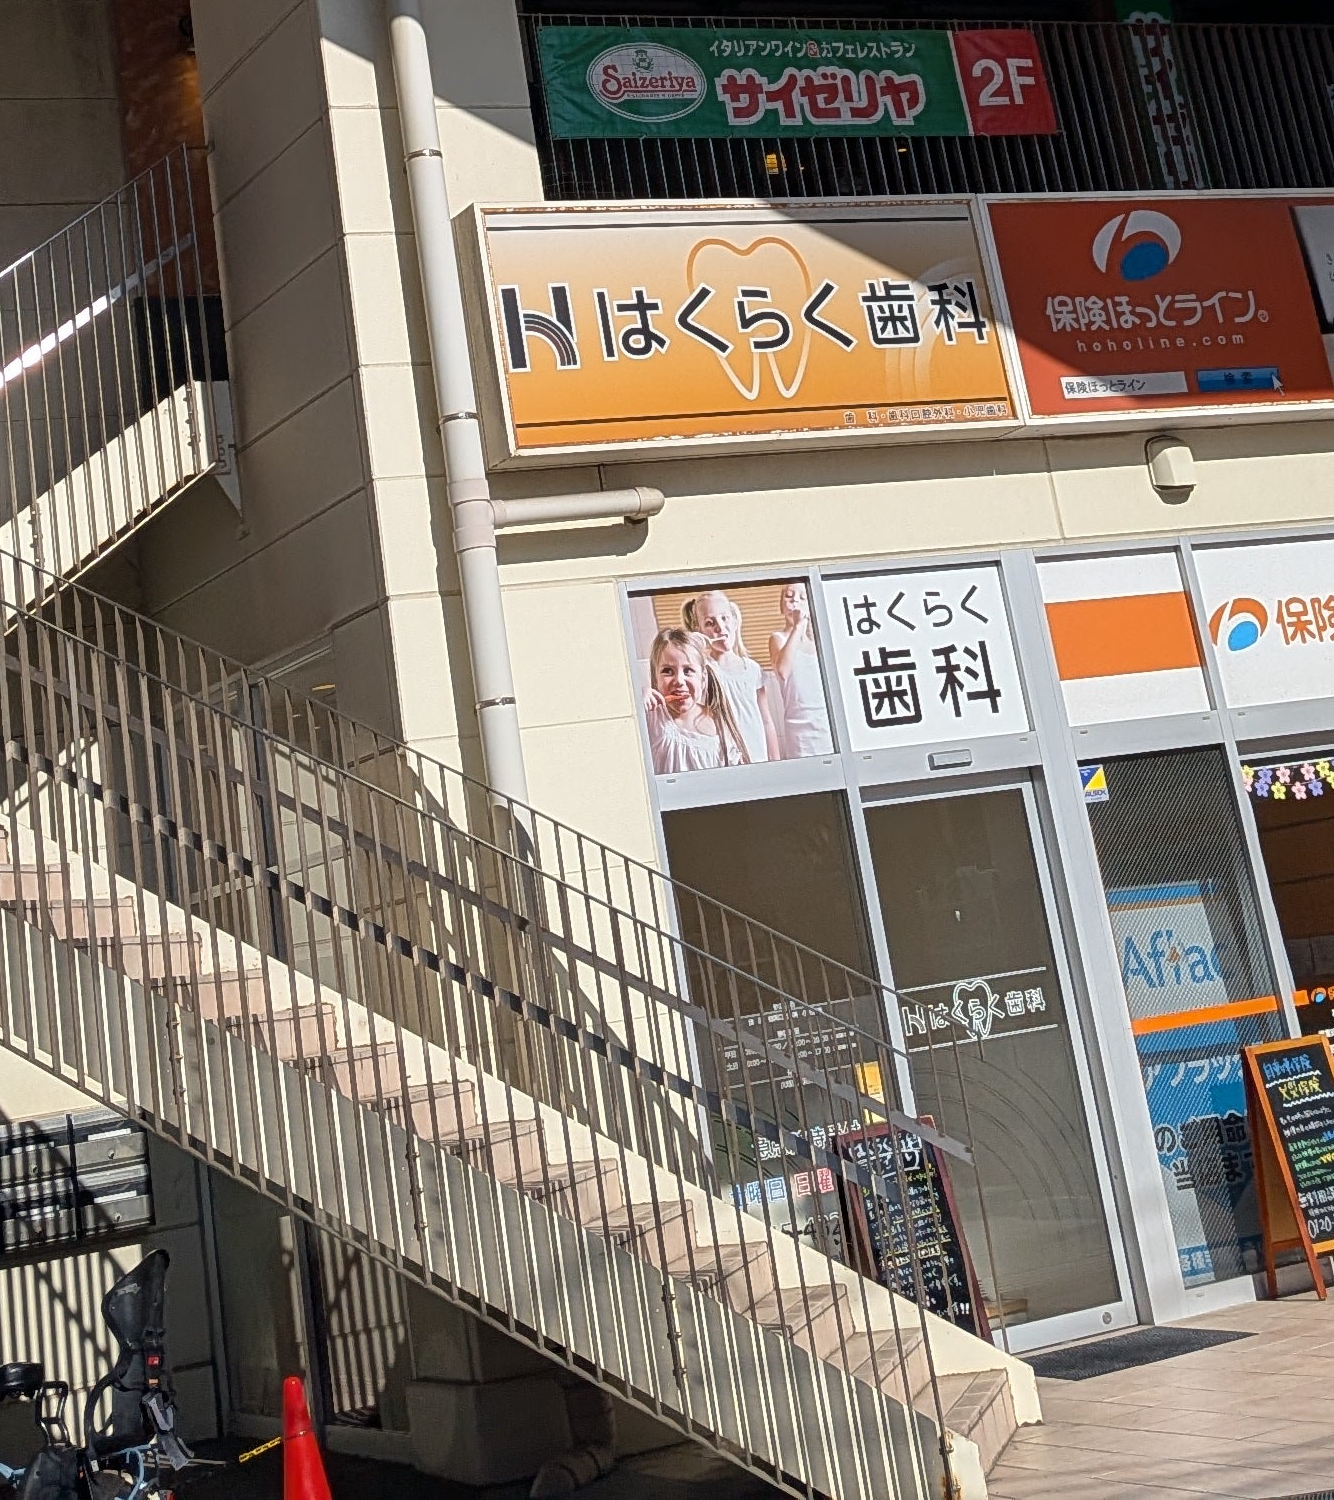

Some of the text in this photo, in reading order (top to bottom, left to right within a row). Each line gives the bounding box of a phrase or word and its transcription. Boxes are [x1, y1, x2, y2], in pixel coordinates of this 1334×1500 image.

[602, 64, 696, 96] Saizeriya
[720, 70, 923, 123] サイゼリヤ
[971, 59, 1036, 106] 2F
[593, 278, 989, 363] はくらく歯科
[1077, 332, 1244, 353] hoholine.com
[1064, 379, 1147, 395] 保険ほっとライン
[842, 585, 989, 637] はくらく
[853, 640, 1002, 729] 歯科
